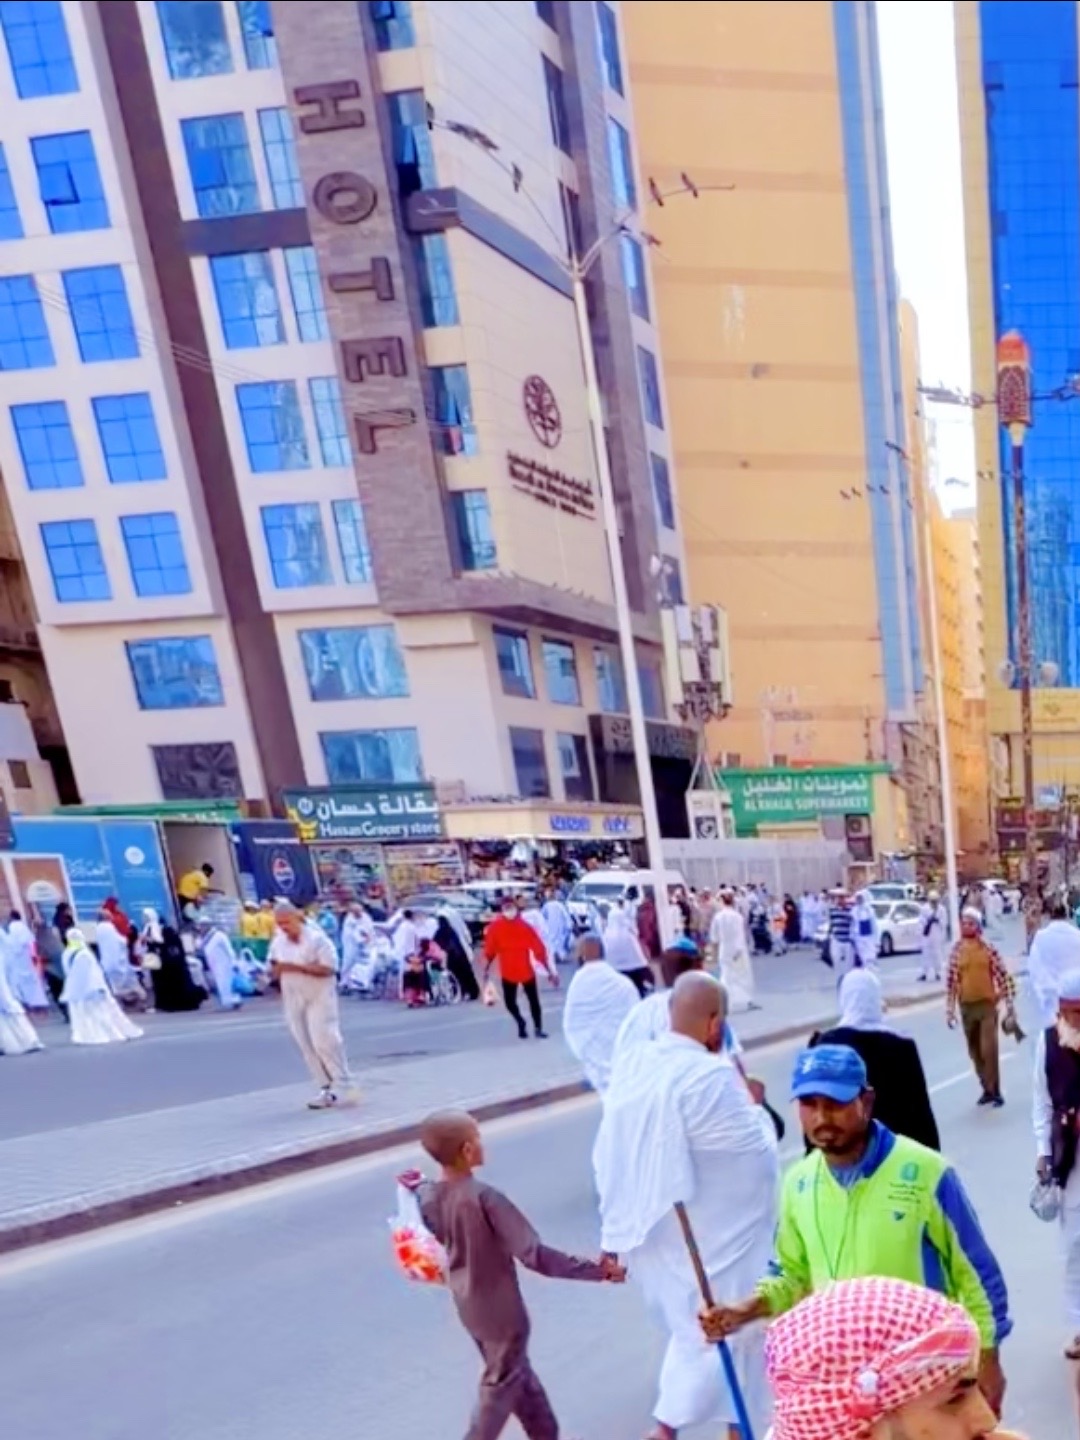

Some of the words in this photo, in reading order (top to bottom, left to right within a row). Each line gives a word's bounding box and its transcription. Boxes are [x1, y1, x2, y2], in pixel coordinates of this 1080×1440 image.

[294, 79, 417, 455] HOTEL
[316, 798, 377, 820] حسان
[379, 793, 439, 819] بقالة
